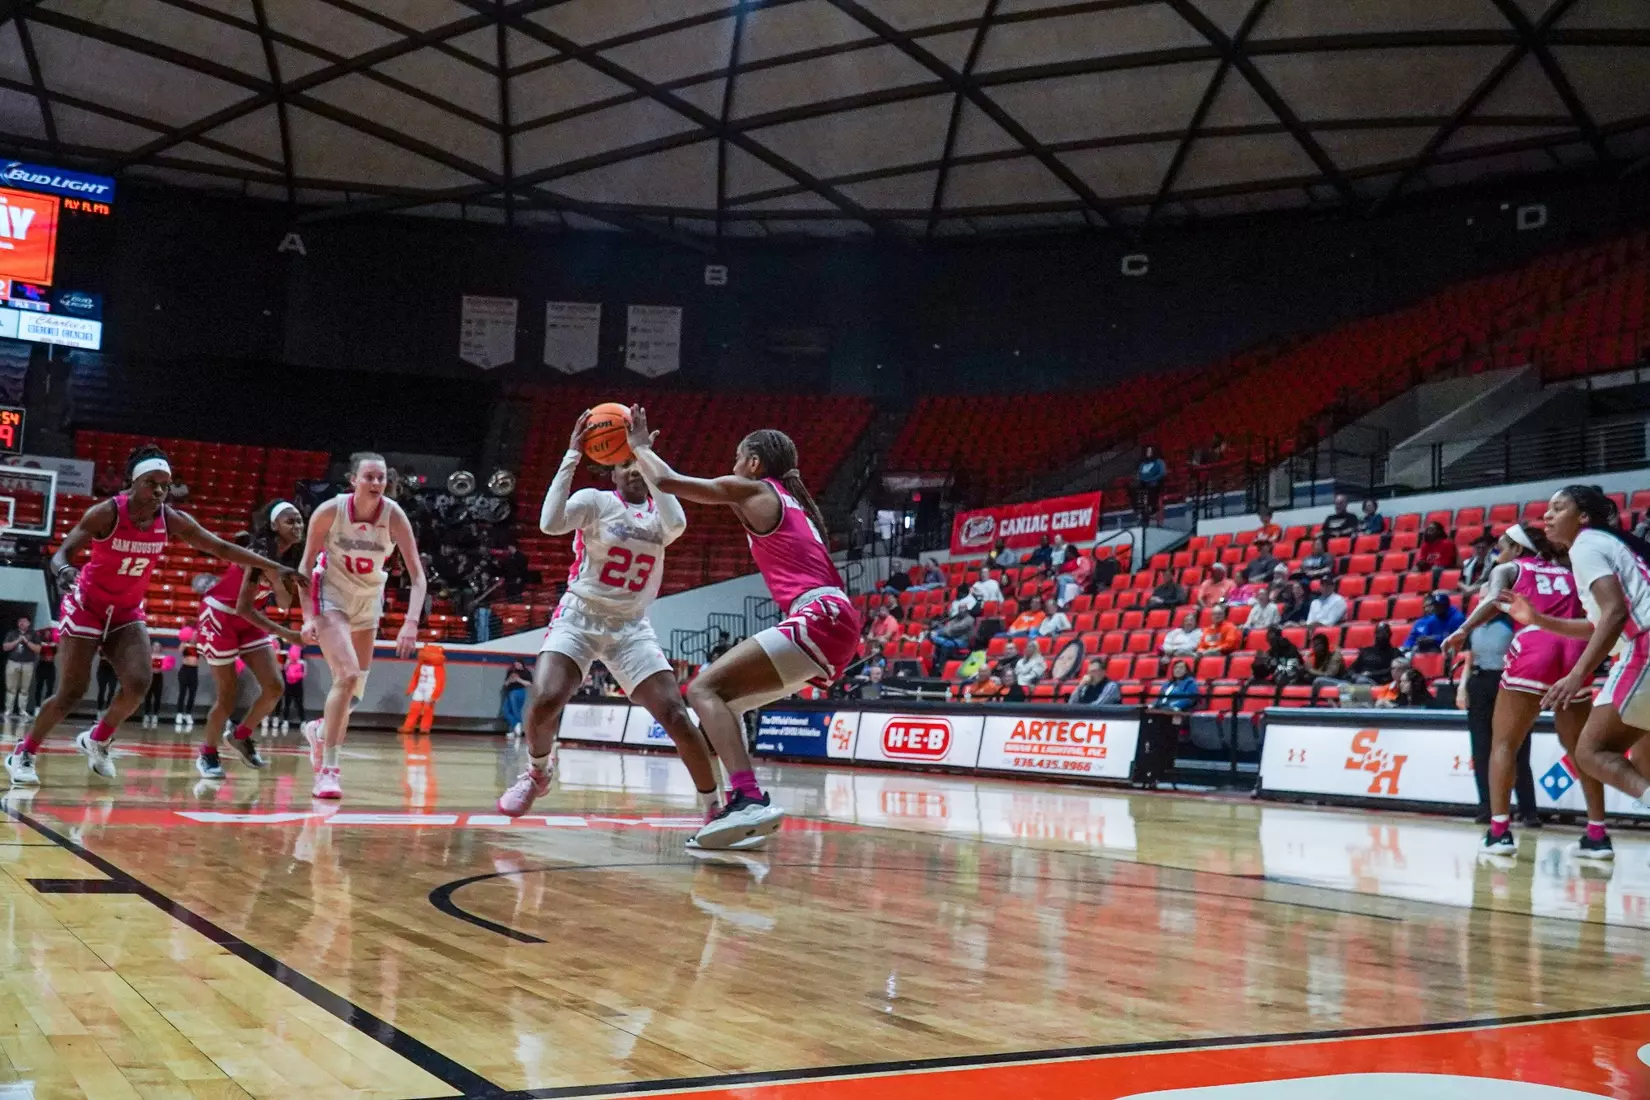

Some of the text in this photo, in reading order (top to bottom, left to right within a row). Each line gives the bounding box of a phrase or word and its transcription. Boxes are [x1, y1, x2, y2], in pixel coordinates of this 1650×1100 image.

[7, 169, 110, 195] BUD LIGHT
[278, 232, 307, 255] A
[704, 264, 728, 285] B
[1121, 255, 1149, 276] C
[1052, 507, 1093, 530] CREW
[111, 538, 131, 552] SAM
[117, 557, 150, 577] 12
[343, 554, 374, 574] 10
[601, 546, 656, 592] 23
[1534, 574, 1571, 595] 24
[1010, 720, 1106, 744] ARTECH
